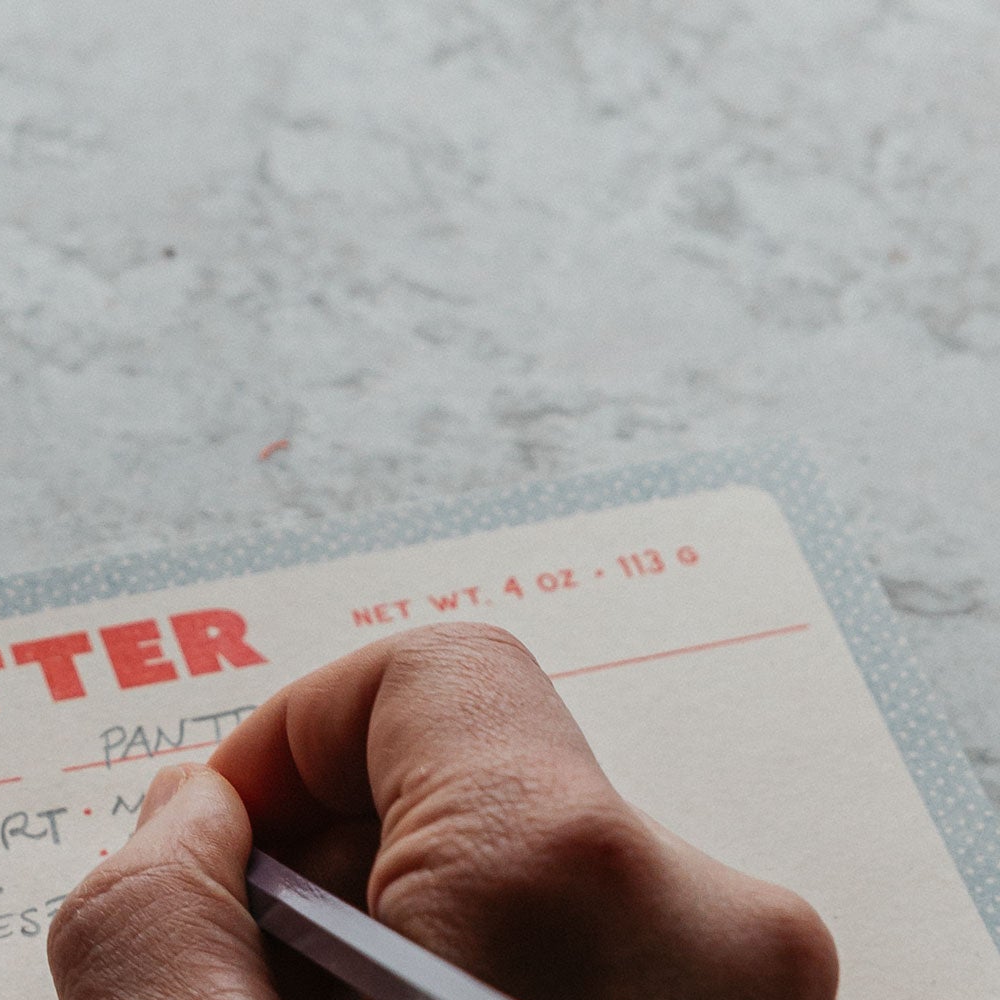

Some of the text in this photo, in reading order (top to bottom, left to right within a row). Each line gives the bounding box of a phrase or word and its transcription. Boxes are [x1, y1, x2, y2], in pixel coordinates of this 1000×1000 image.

[351, 598, 411, 628] NET
[427, 585, 495, 613] WT.
[503, 575, 525, 600] 4
[535, 568, 579, 593] OZ
[616, 548, 666, 578] 113
